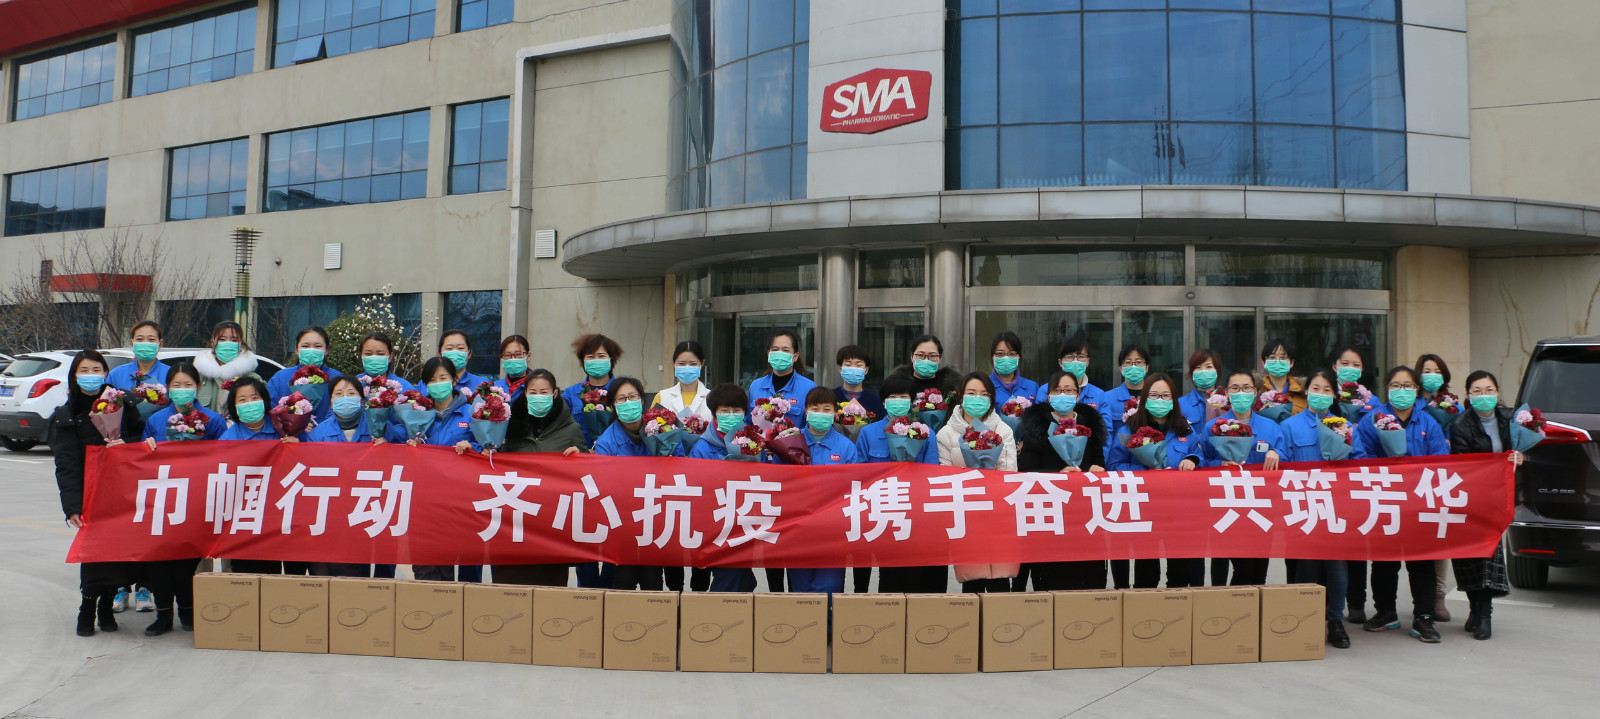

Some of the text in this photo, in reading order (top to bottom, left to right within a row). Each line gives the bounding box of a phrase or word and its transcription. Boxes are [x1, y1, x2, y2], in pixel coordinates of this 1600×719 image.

[831, 76, 916, 119] SMA
[842, 113, 901, 126] PHARMAUTOMATIC
[132, 462, 1469, 550] 巾帼行动 齐心抗疫 携手奋进 共筑芳华
